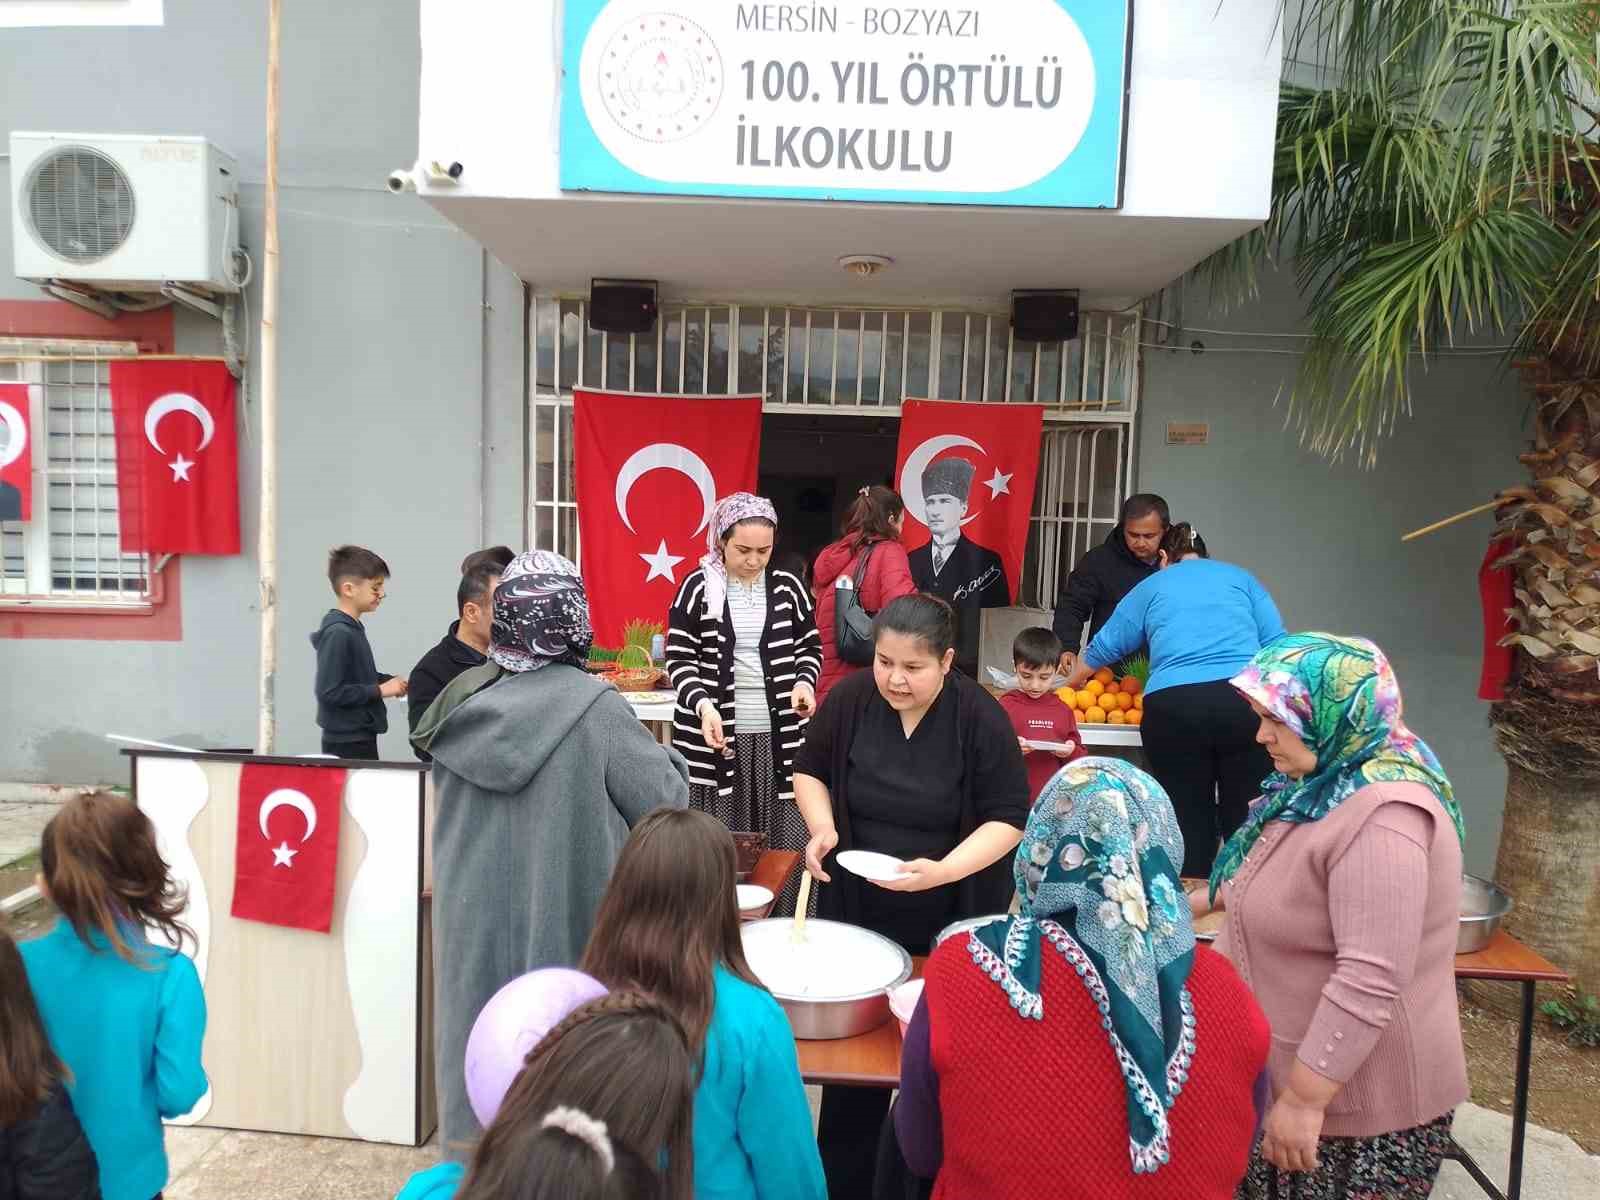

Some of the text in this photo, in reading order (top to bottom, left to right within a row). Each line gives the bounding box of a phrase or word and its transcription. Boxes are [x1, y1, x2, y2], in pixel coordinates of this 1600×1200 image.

[736, 1, 838, 33] MERSİN
[864, 7, 979, 37] BOZYAZI
[741, 60, 820, 102] 100.
[830, 61, 889, 105] YIL
[900, 51, 1062, 109] ÖRTÜLÜ
[736, 114, 952, 173] İLKOKULU
